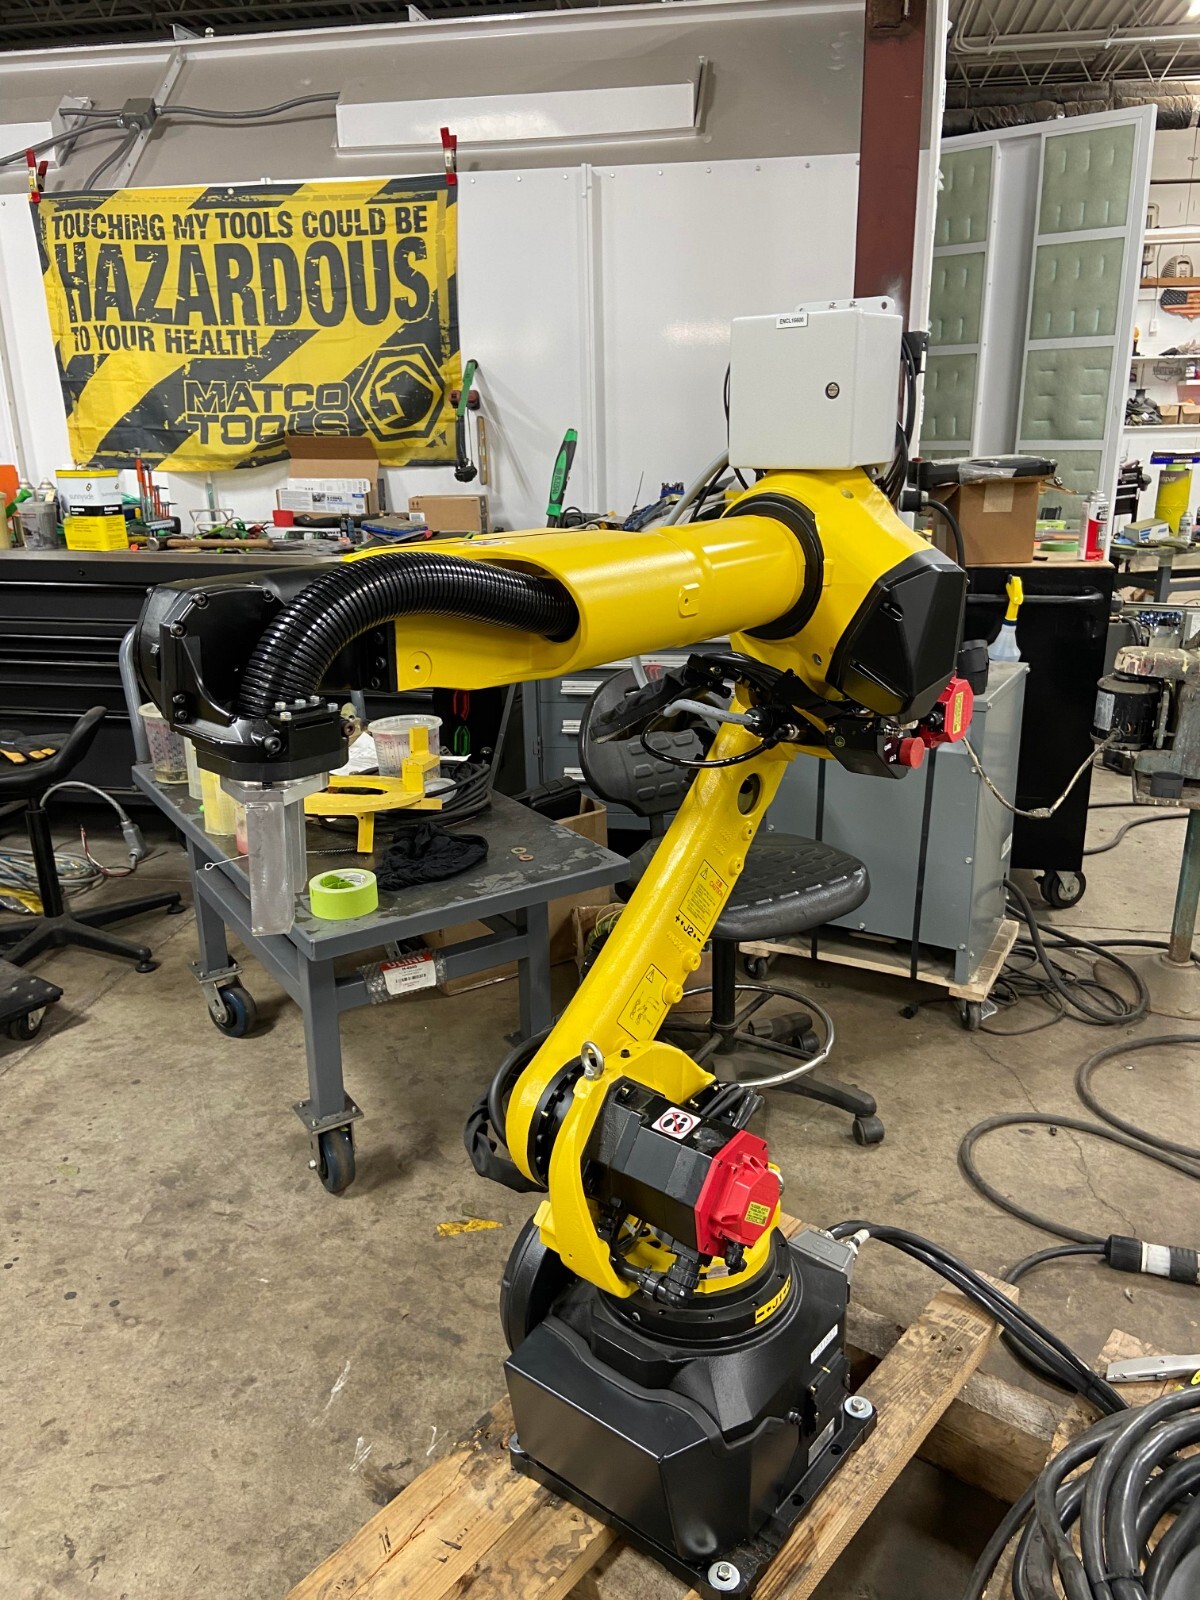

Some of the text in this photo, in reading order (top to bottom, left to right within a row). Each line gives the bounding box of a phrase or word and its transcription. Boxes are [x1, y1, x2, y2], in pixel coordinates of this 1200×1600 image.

[52, 205, 428, 240] TOUCHING MY TOOLS COULD BE
[54, 236, 431, 328] HAZARDOUS
[70, 324, 260, 356] TO YOUR HEALTH
[183, 379, 350, 413] MATCO
[185, 412, 350, 446] TOOLS
